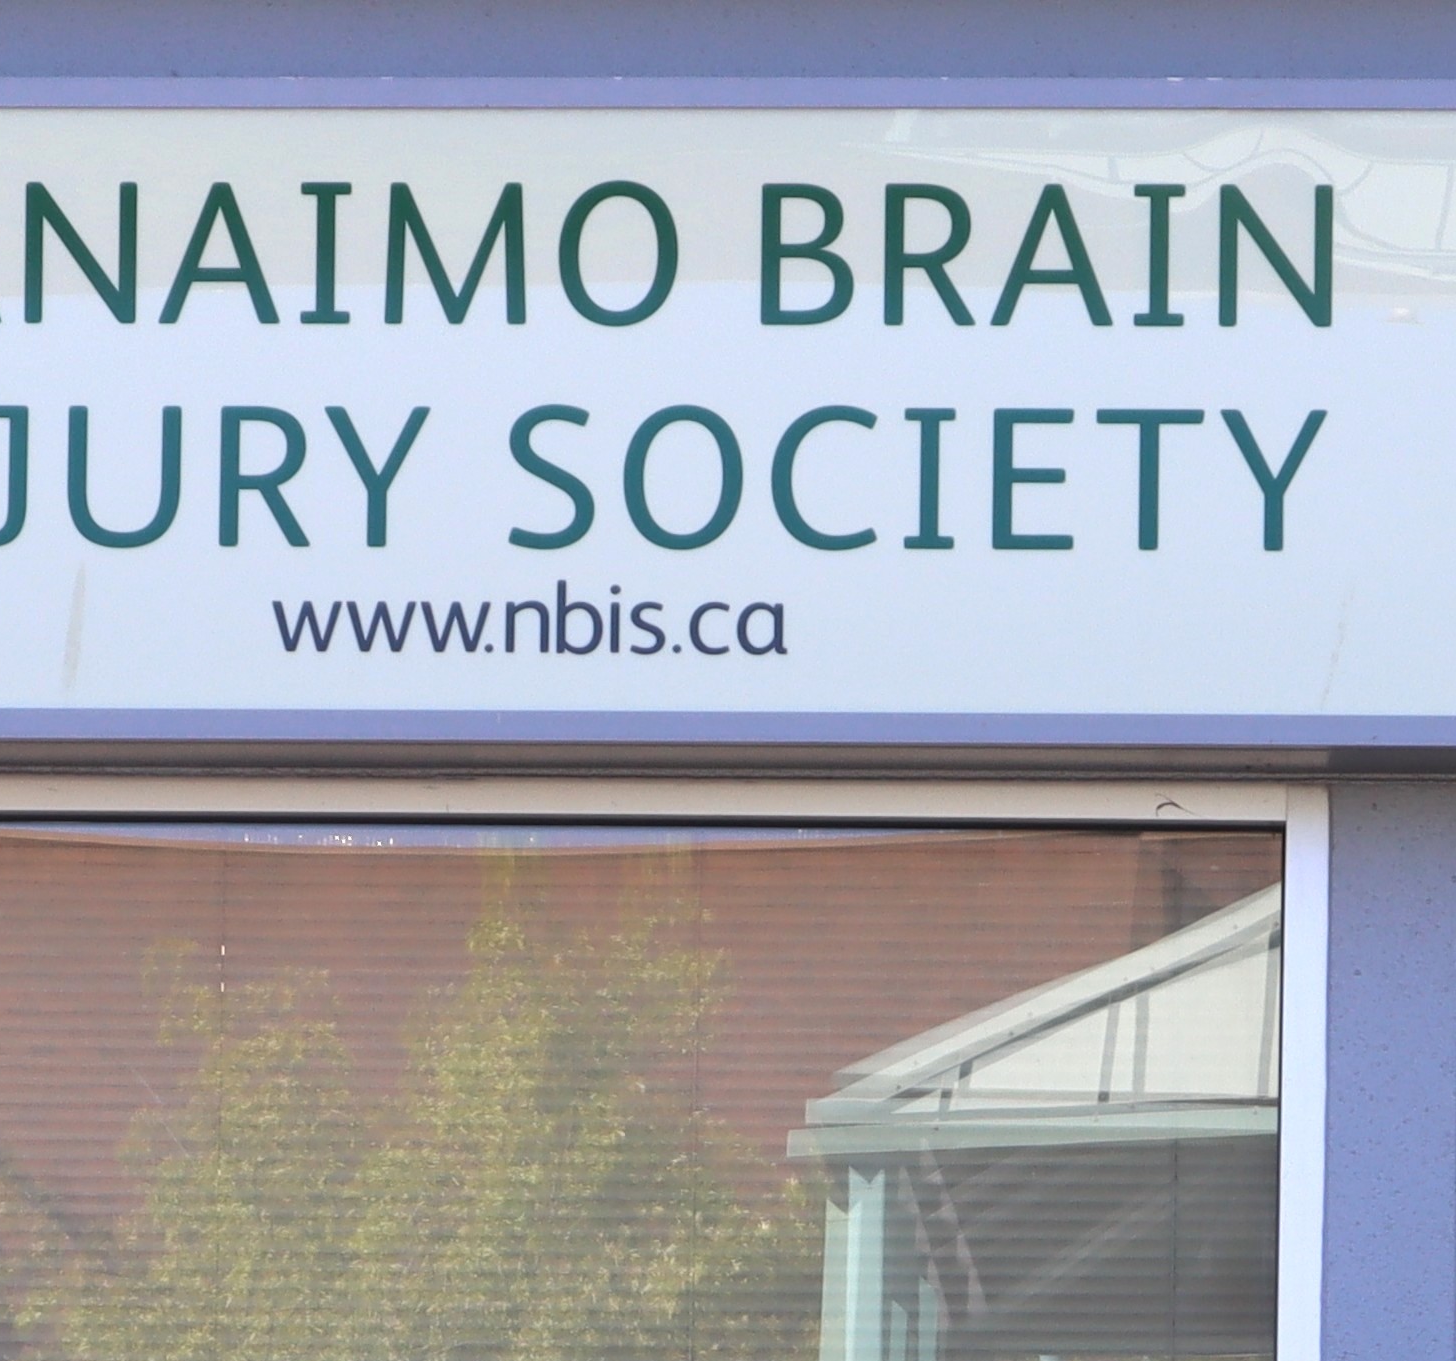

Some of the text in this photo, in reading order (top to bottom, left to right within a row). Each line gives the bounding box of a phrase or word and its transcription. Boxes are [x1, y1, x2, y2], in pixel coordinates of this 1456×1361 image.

[760, 183, 1334, 328] BRAIN
[508, 404, 1328, 552] SOCIETY
[272, 579, 788, 656] www.nbis.ca
